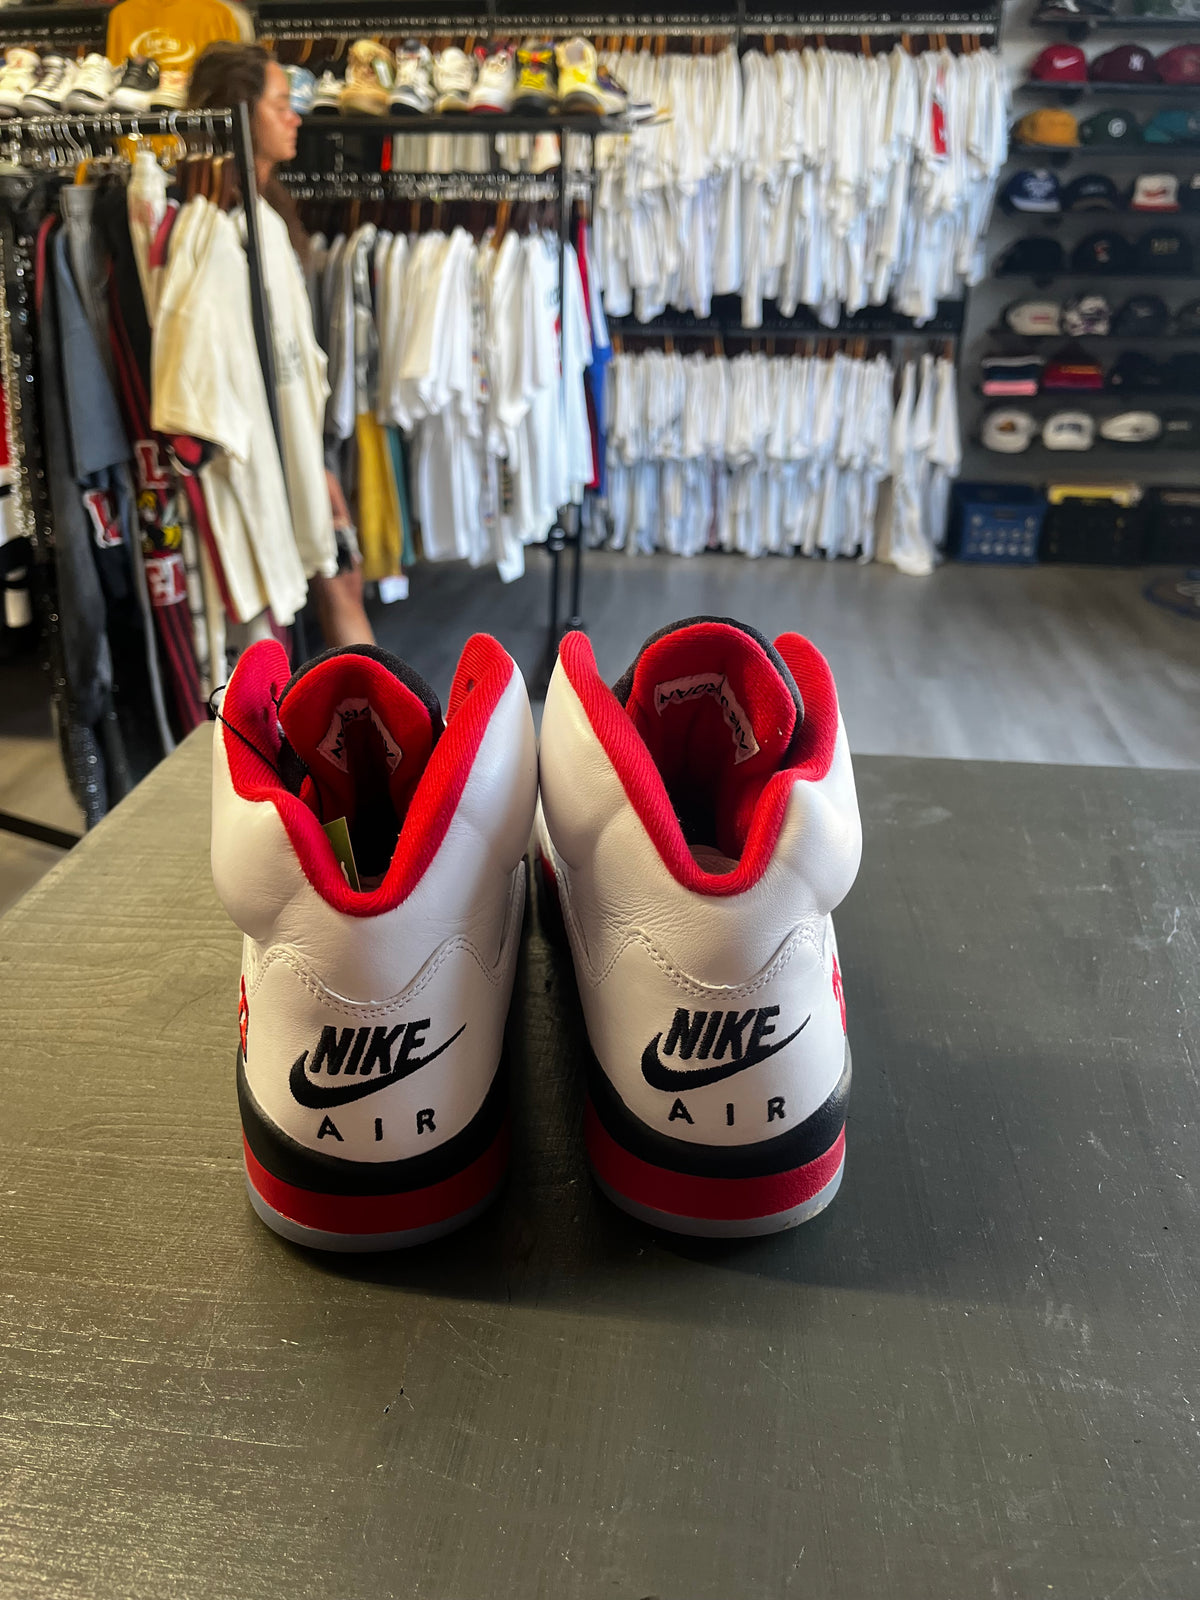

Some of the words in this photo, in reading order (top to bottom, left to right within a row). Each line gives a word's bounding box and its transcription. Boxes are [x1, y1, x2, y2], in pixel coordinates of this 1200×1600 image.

[309, 1017, 430, 1075] NIKE
[663, 1004, 780, 1060] NIKE
[317, 1108, 436, 1142] AIR
[668, 1096, 786, 1126] AIR
